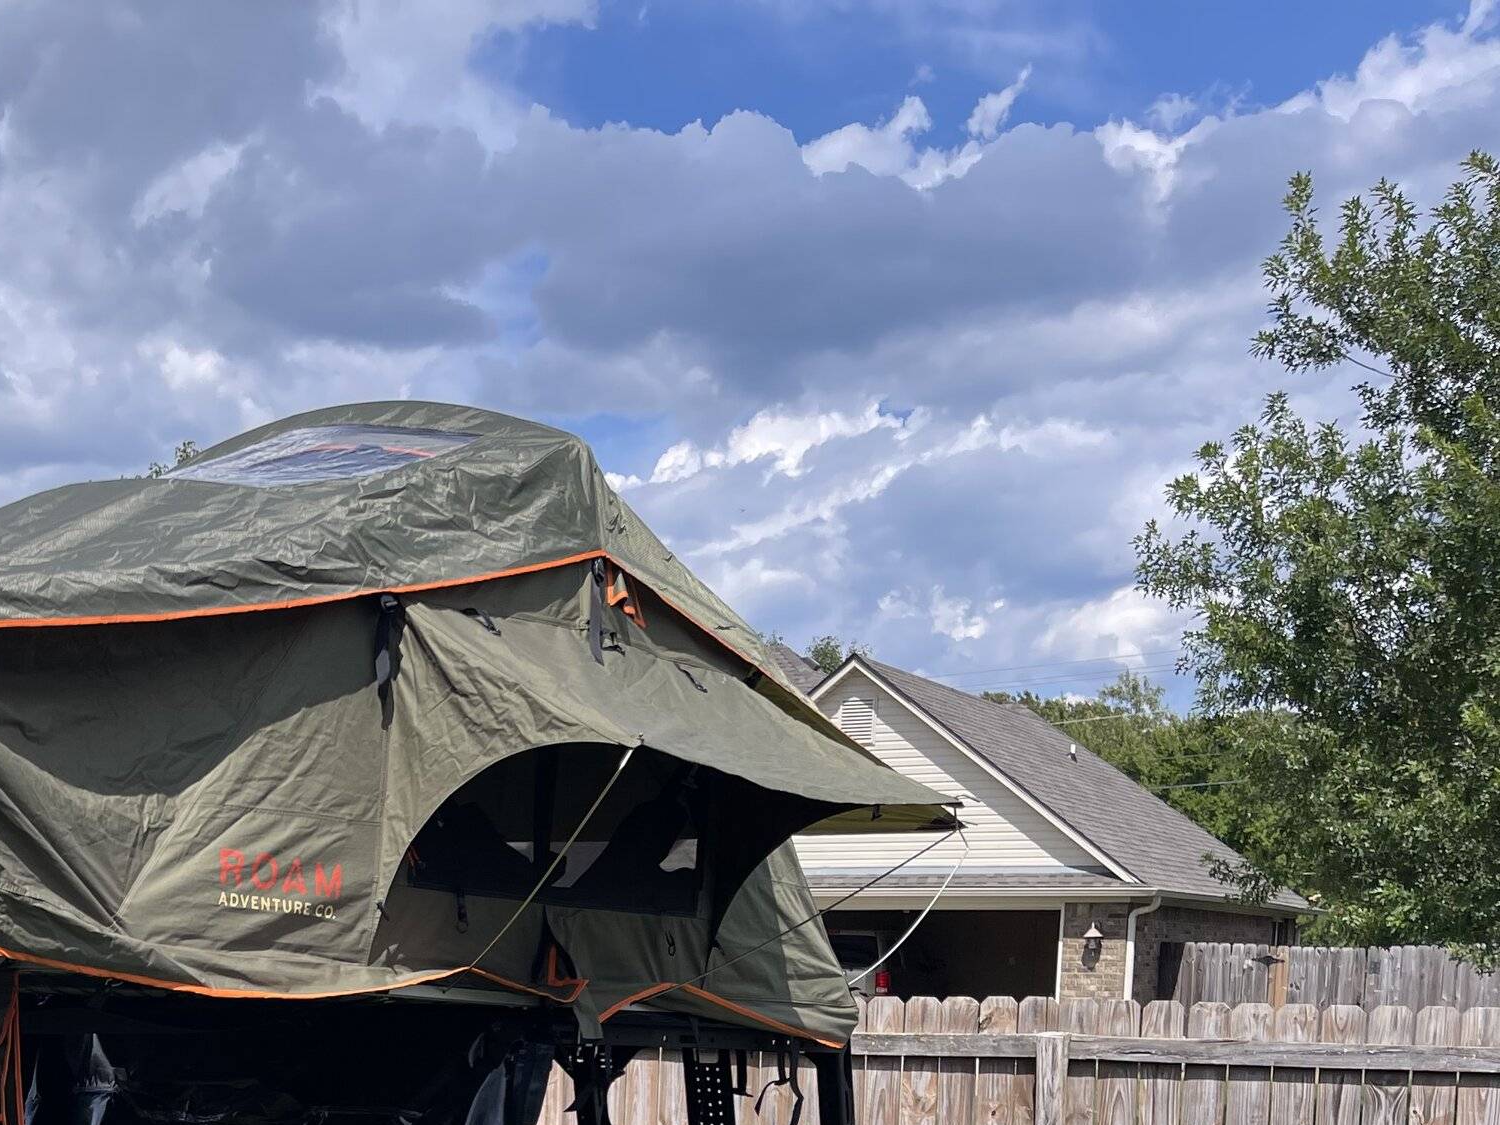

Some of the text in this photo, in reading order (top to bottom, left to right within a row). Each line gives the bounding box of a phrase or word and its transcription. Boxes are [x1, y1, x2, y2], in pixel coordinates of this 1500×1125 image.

[218, 847, 343, 898] ROAM
[218, 891, 337, 920] ADVENTURE CO.
